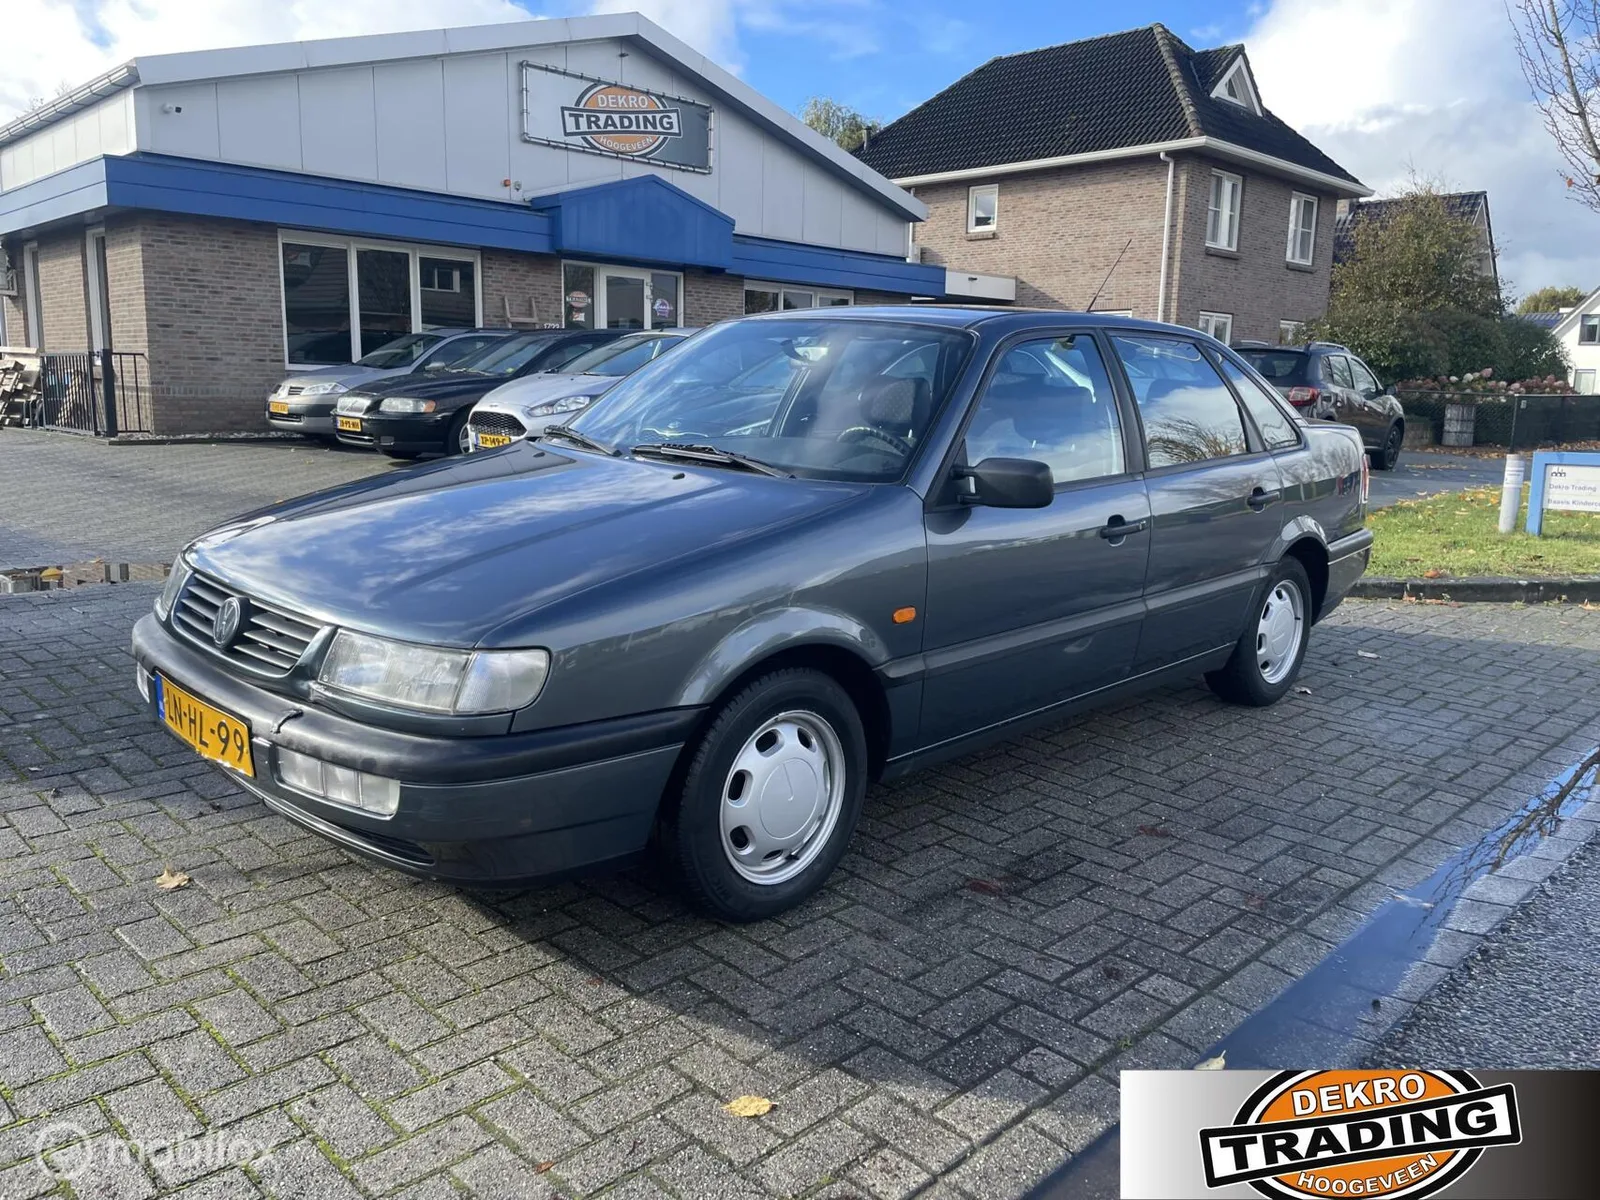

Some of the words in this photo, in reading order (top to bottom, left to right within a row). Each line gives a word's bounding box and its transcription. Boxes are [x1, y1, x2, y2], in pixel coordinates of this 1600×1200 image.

[597, 94, 649, 108] DEKRO
[568, 112, 674, 131] TRADING
[600, 136, 653, 151] HOOGEVEEN
[1549, 483, 1569, 491] Dekro
[1571, 484, 1597, 493] Trading
[166, 687, 245, 763] LN-HL-99
